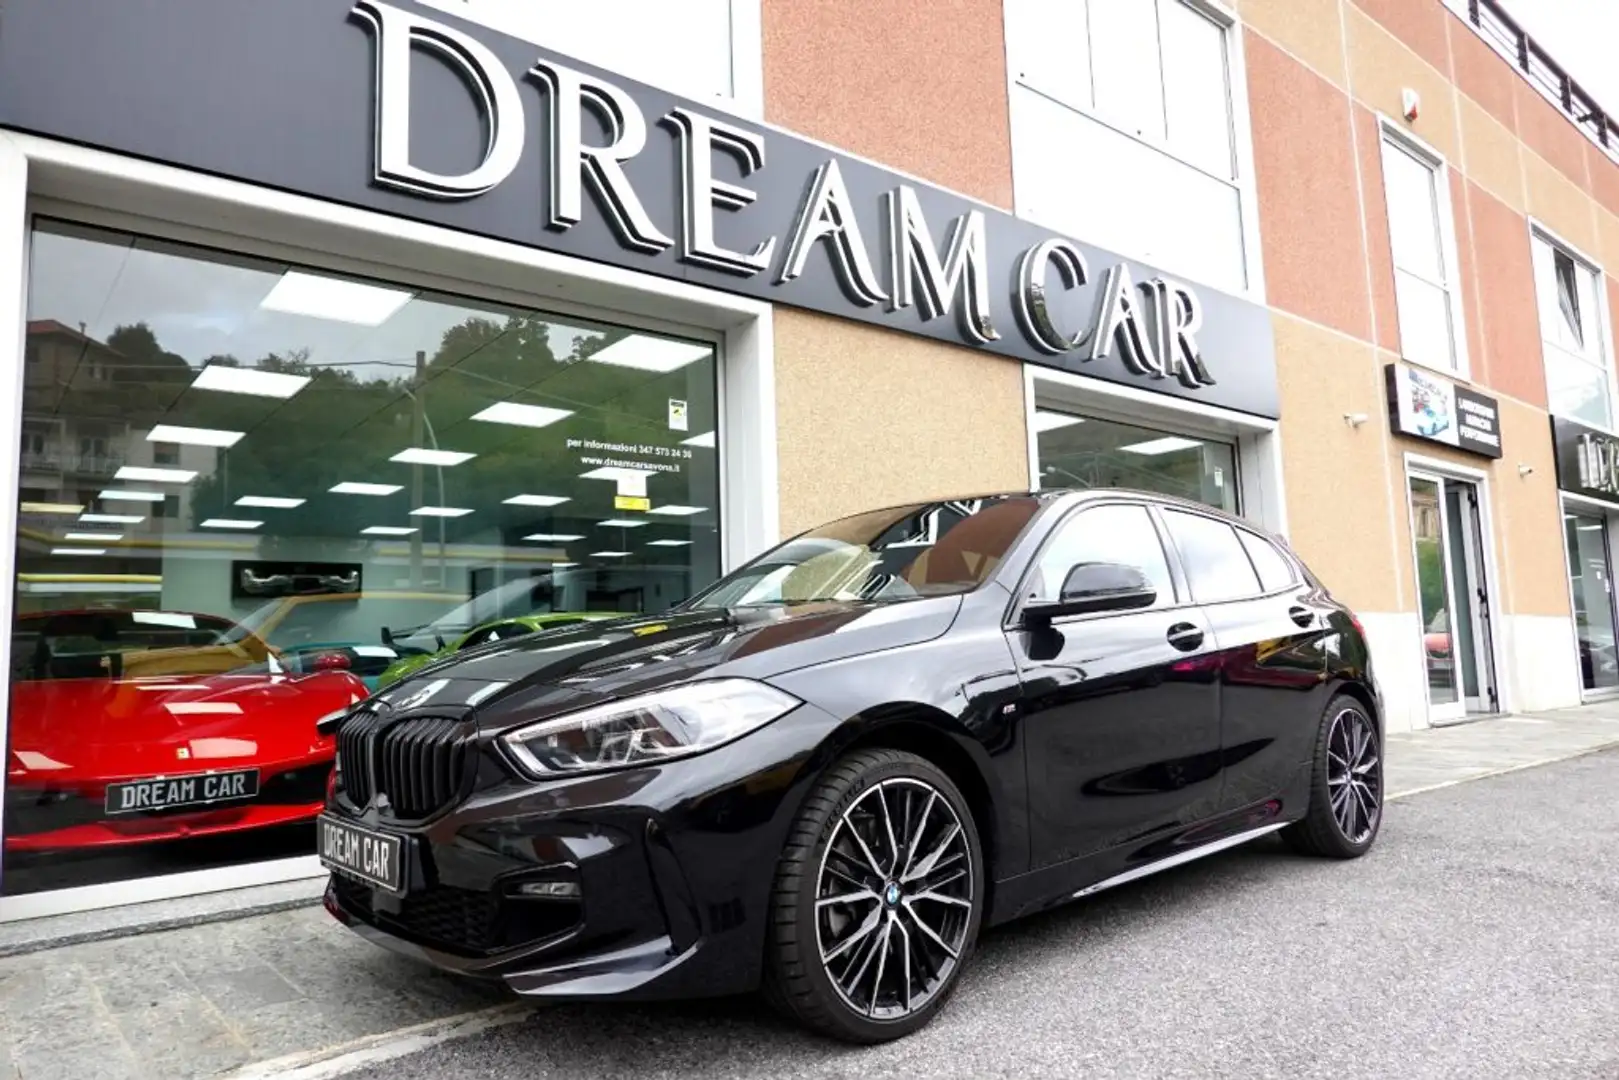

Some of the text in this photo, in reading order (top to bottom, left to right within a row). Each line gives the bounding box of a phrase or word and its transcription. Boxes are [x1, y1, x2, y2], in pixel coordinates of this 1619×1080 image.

[350, 0, 1217, 389] DREAM CAR
[566, 439, 582, 448] per
[584, 439, 637, 453] informazioni
[580, 456, 680, 472] www.dreamcarsavona.it
[121, 774, 245, 809] DREAM CAR
[323, 822, 390, 881] DREAM CAR
